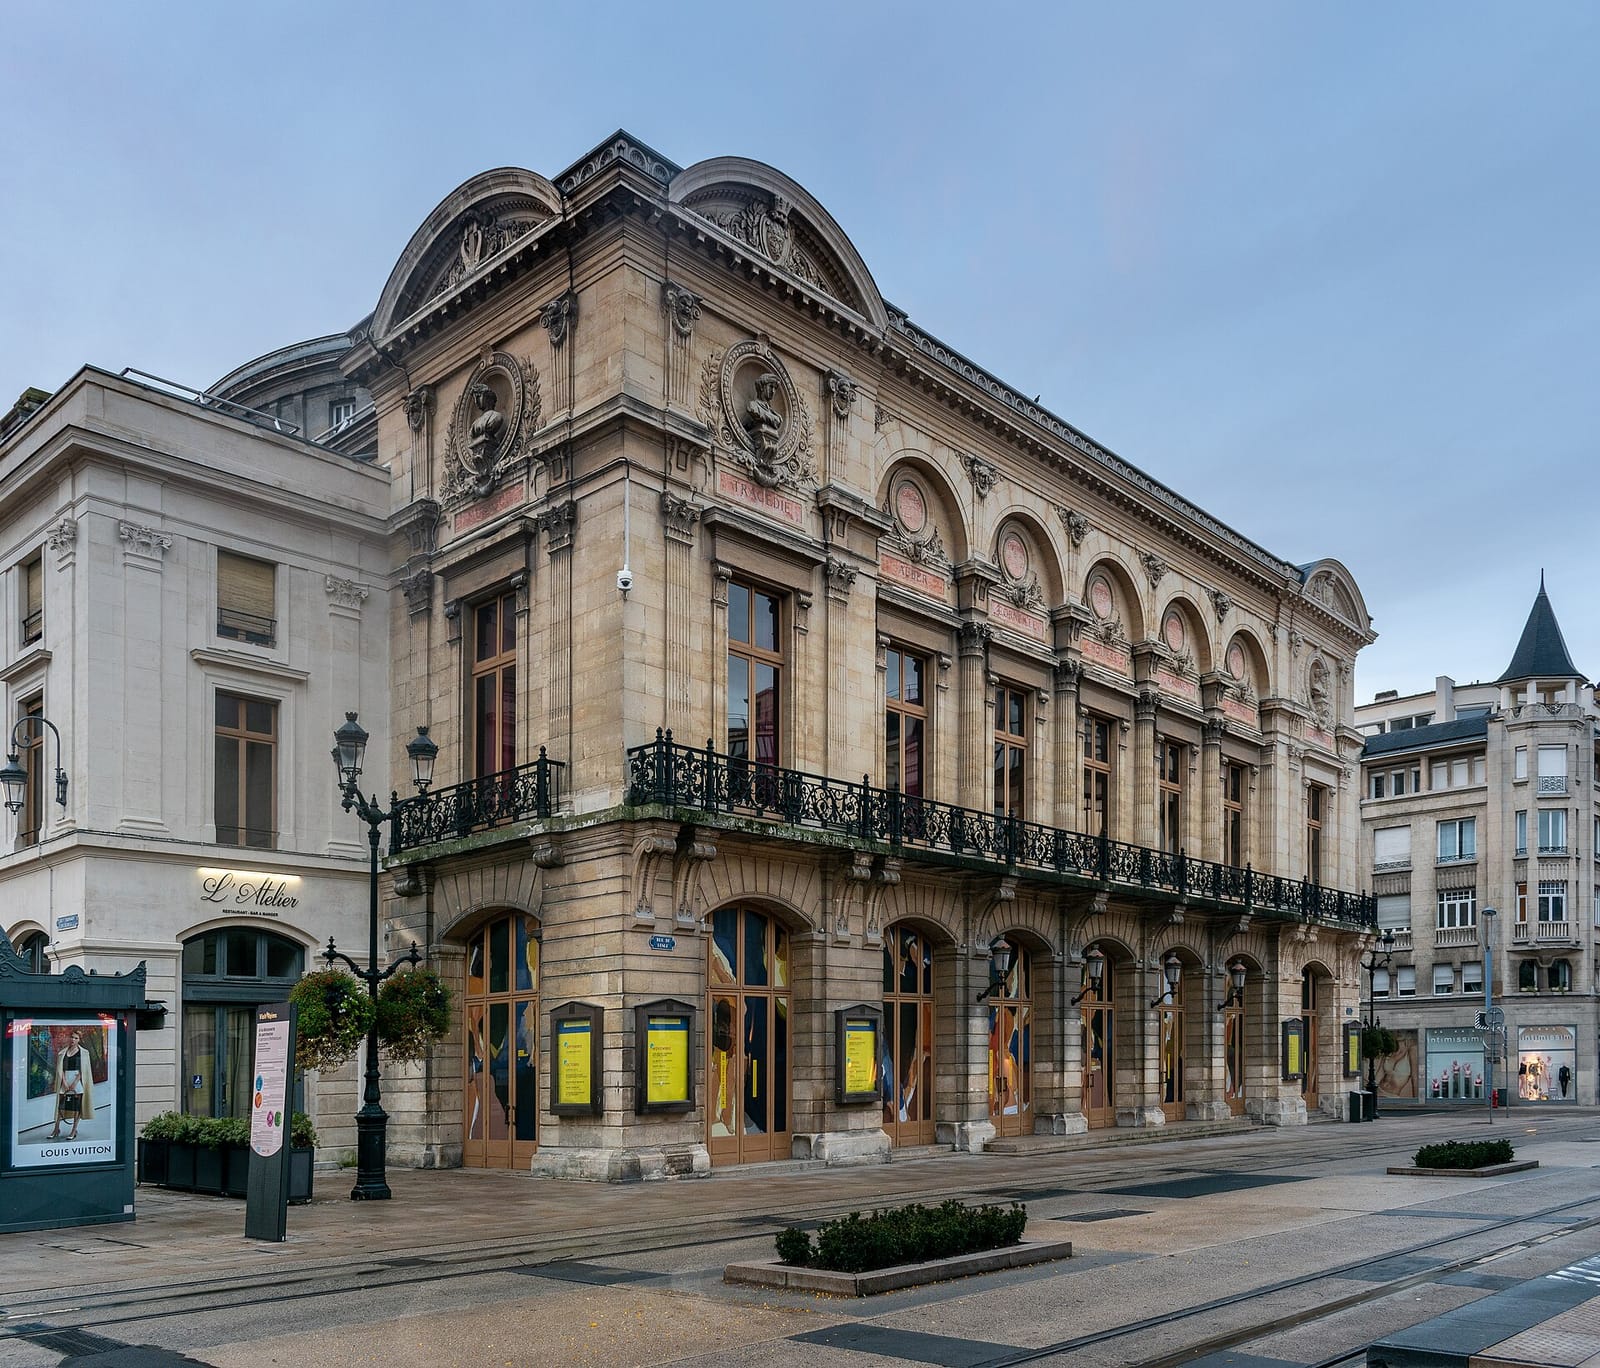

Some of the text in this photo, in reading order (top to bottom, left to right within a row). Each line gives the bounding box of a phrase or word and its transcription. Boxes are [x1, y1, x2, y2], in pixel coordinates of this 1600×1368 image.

[200, 872, 299, 908] L'Atelier
[41, 1146, 111, 1158] LOUIS VUITTON
